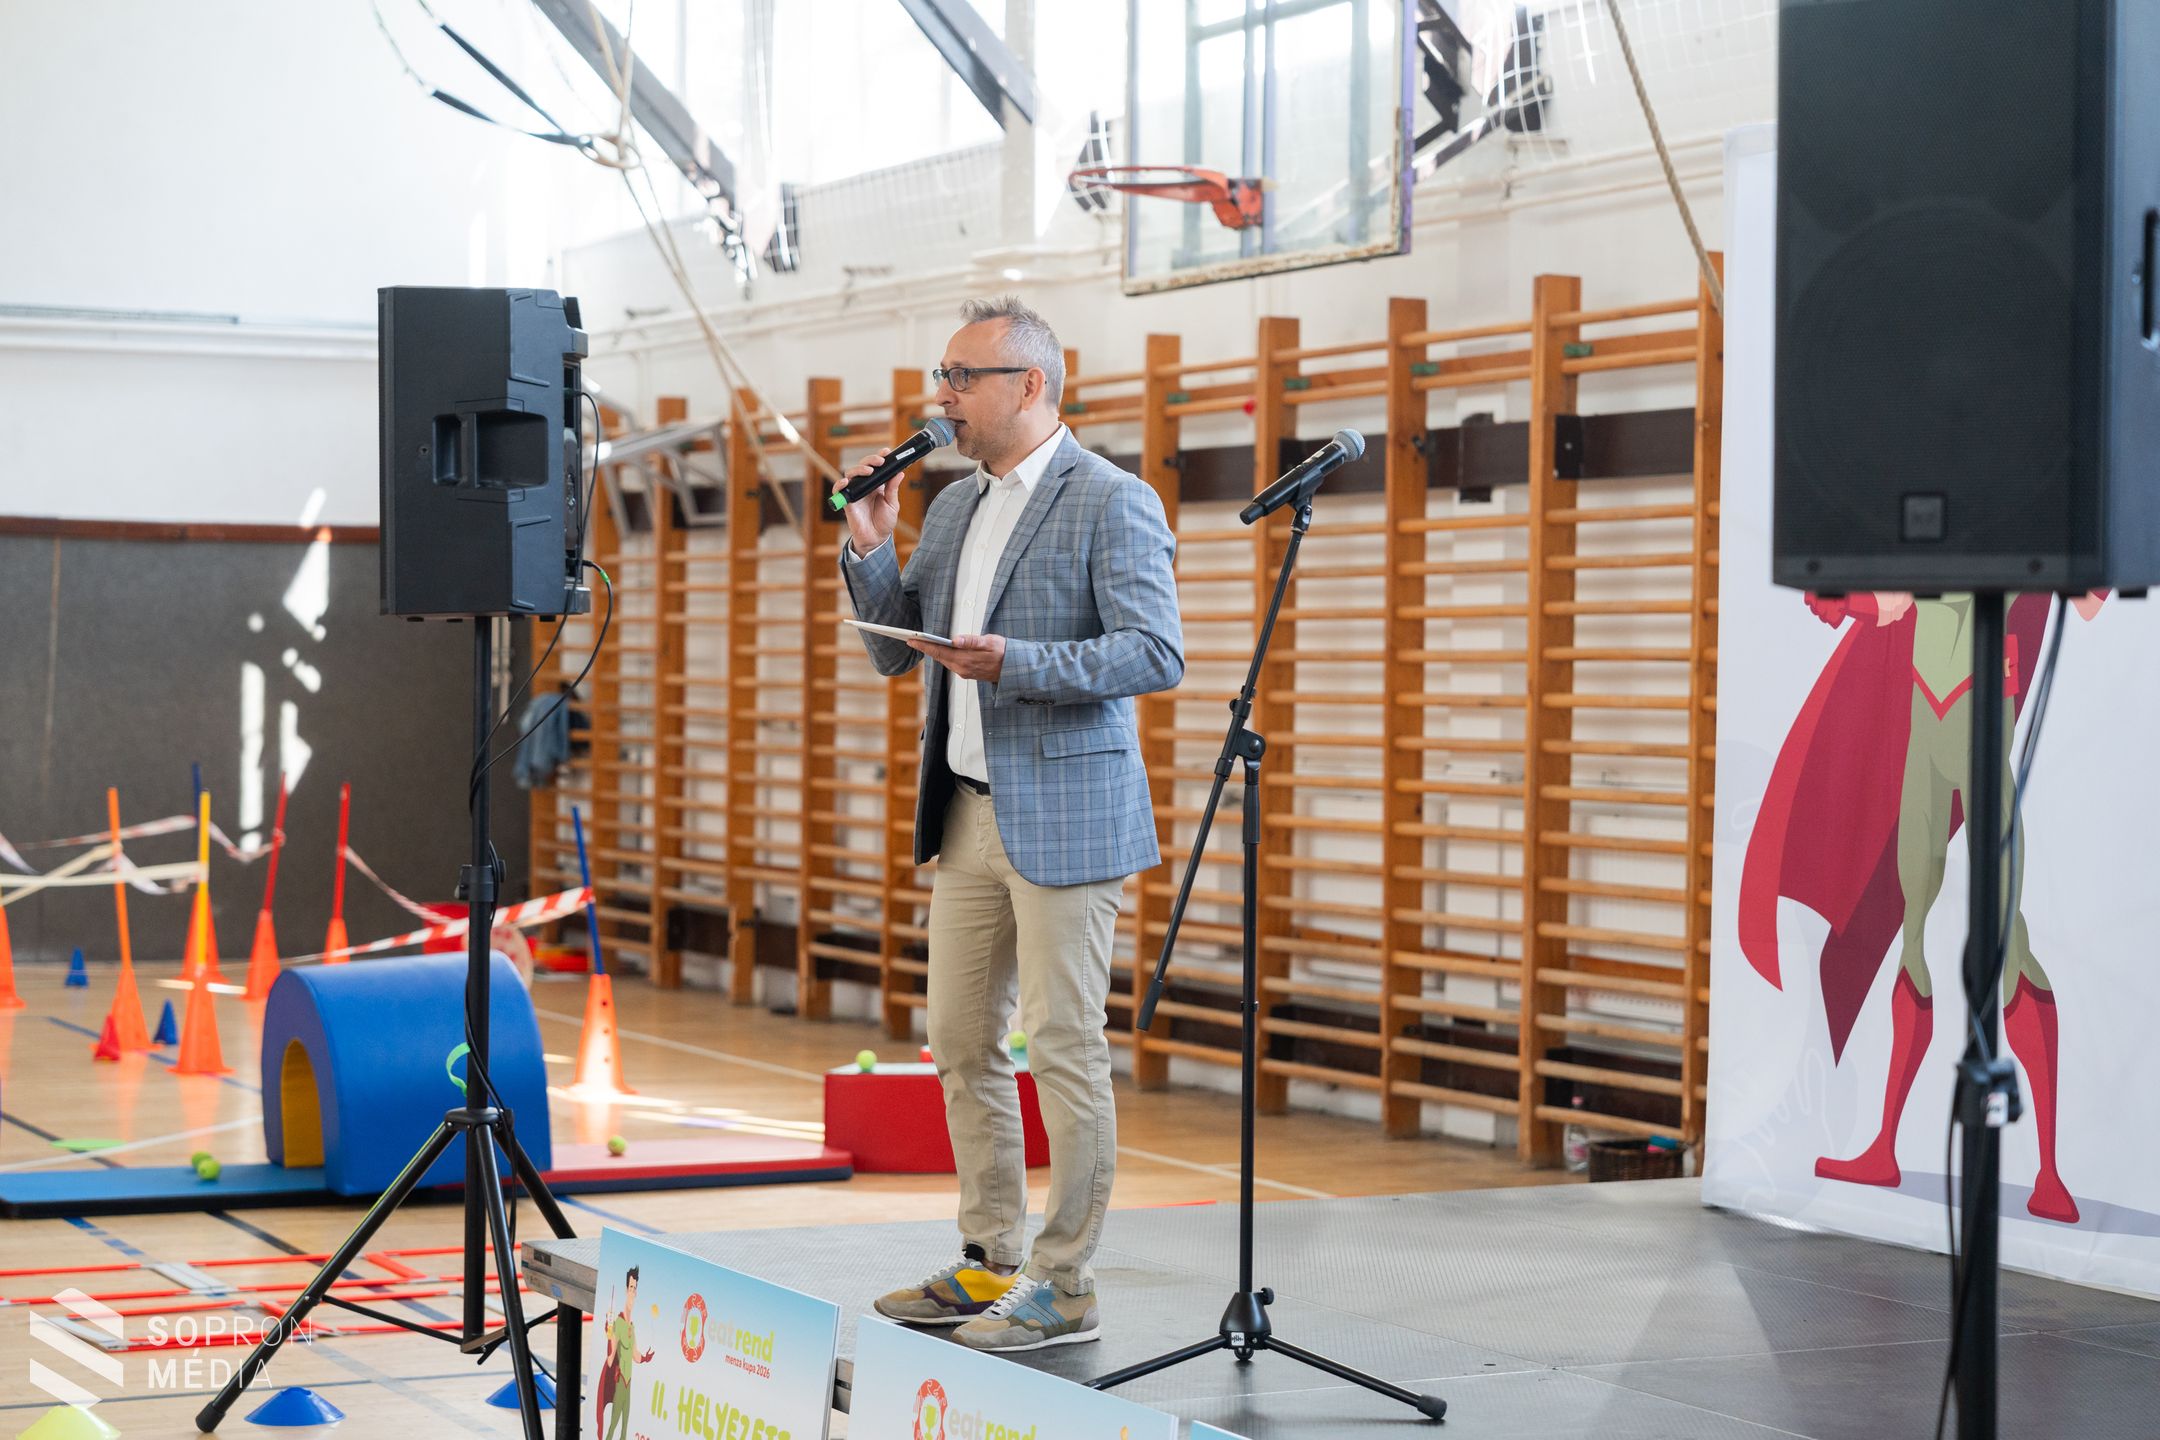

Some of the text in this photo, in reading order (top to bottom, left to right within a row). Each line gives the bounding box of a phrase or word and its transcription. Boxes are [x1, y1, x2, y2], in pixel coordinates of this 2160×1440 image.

[708, 1320, 775, 1364] eatrend
[725, 1354, 742, 1368] menza
[742, 1357, 756, 1375] kupa
[677, 1385, 791, 1440] HELYEZE
